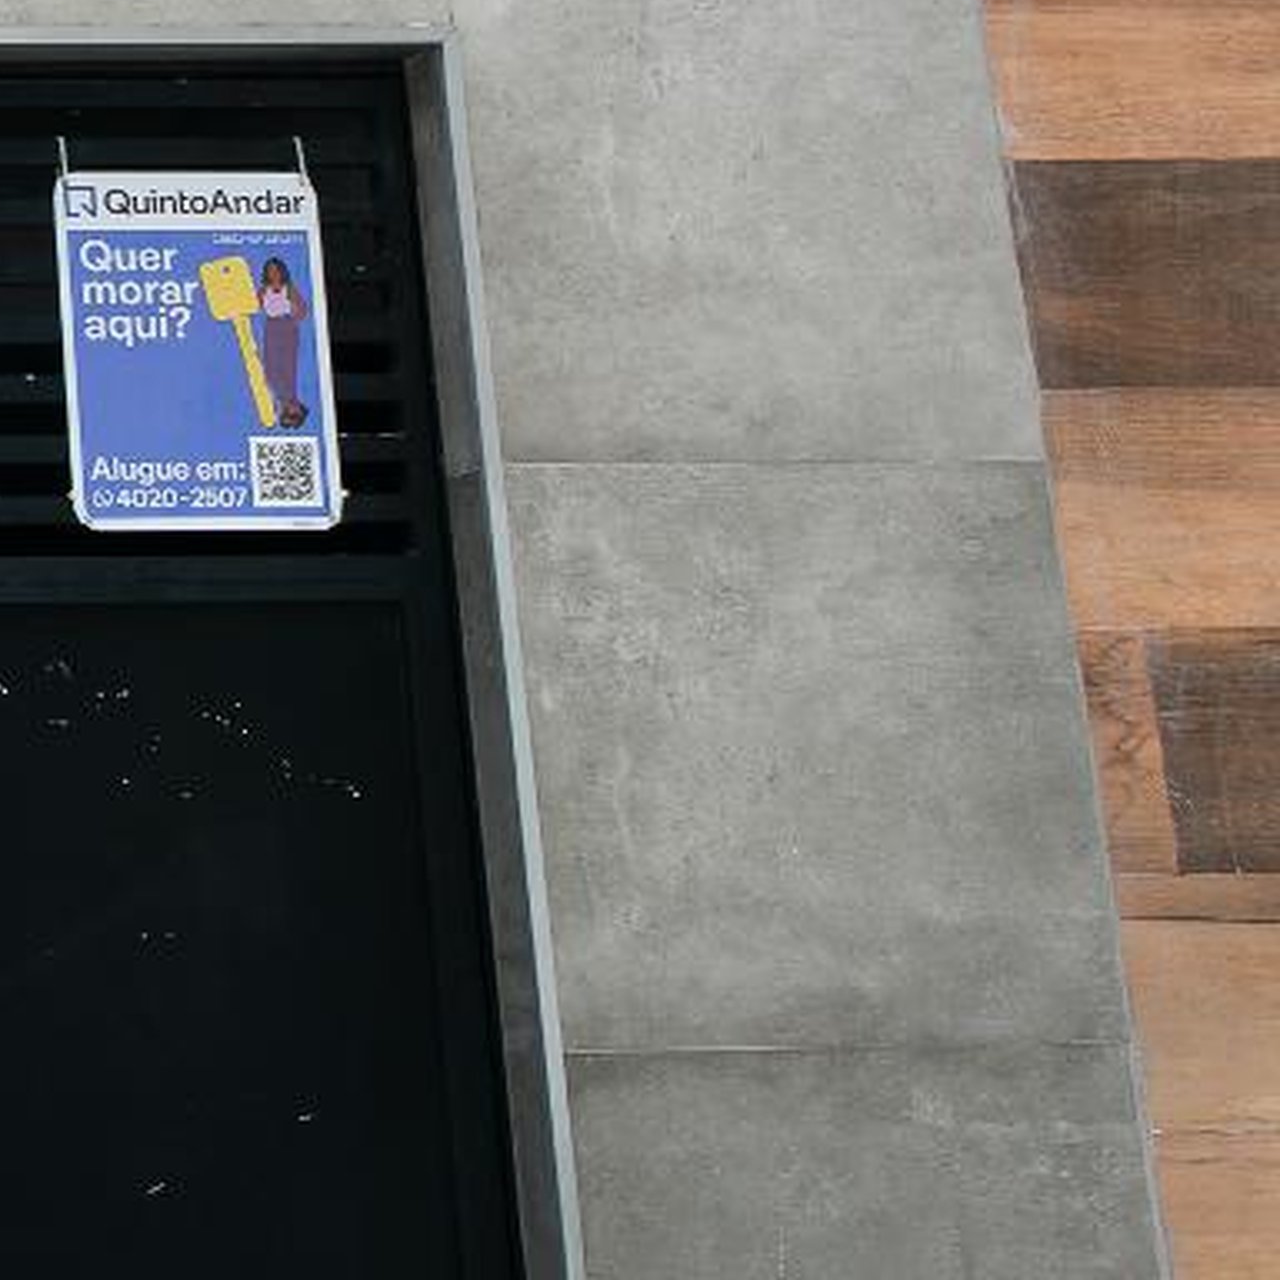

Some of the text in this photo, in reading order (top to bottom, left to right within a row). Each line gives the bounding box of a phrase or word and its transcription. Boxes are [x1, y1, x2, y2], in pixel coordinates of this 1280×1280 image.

[104, 189, 305, 215] QuintoAndar
[79, 239, 178, 273] Quer
[83, 280, 200, 306] morar
[84, 308, 191, 347] aqui?
[91, 456, 246, 486] Alugue em:
